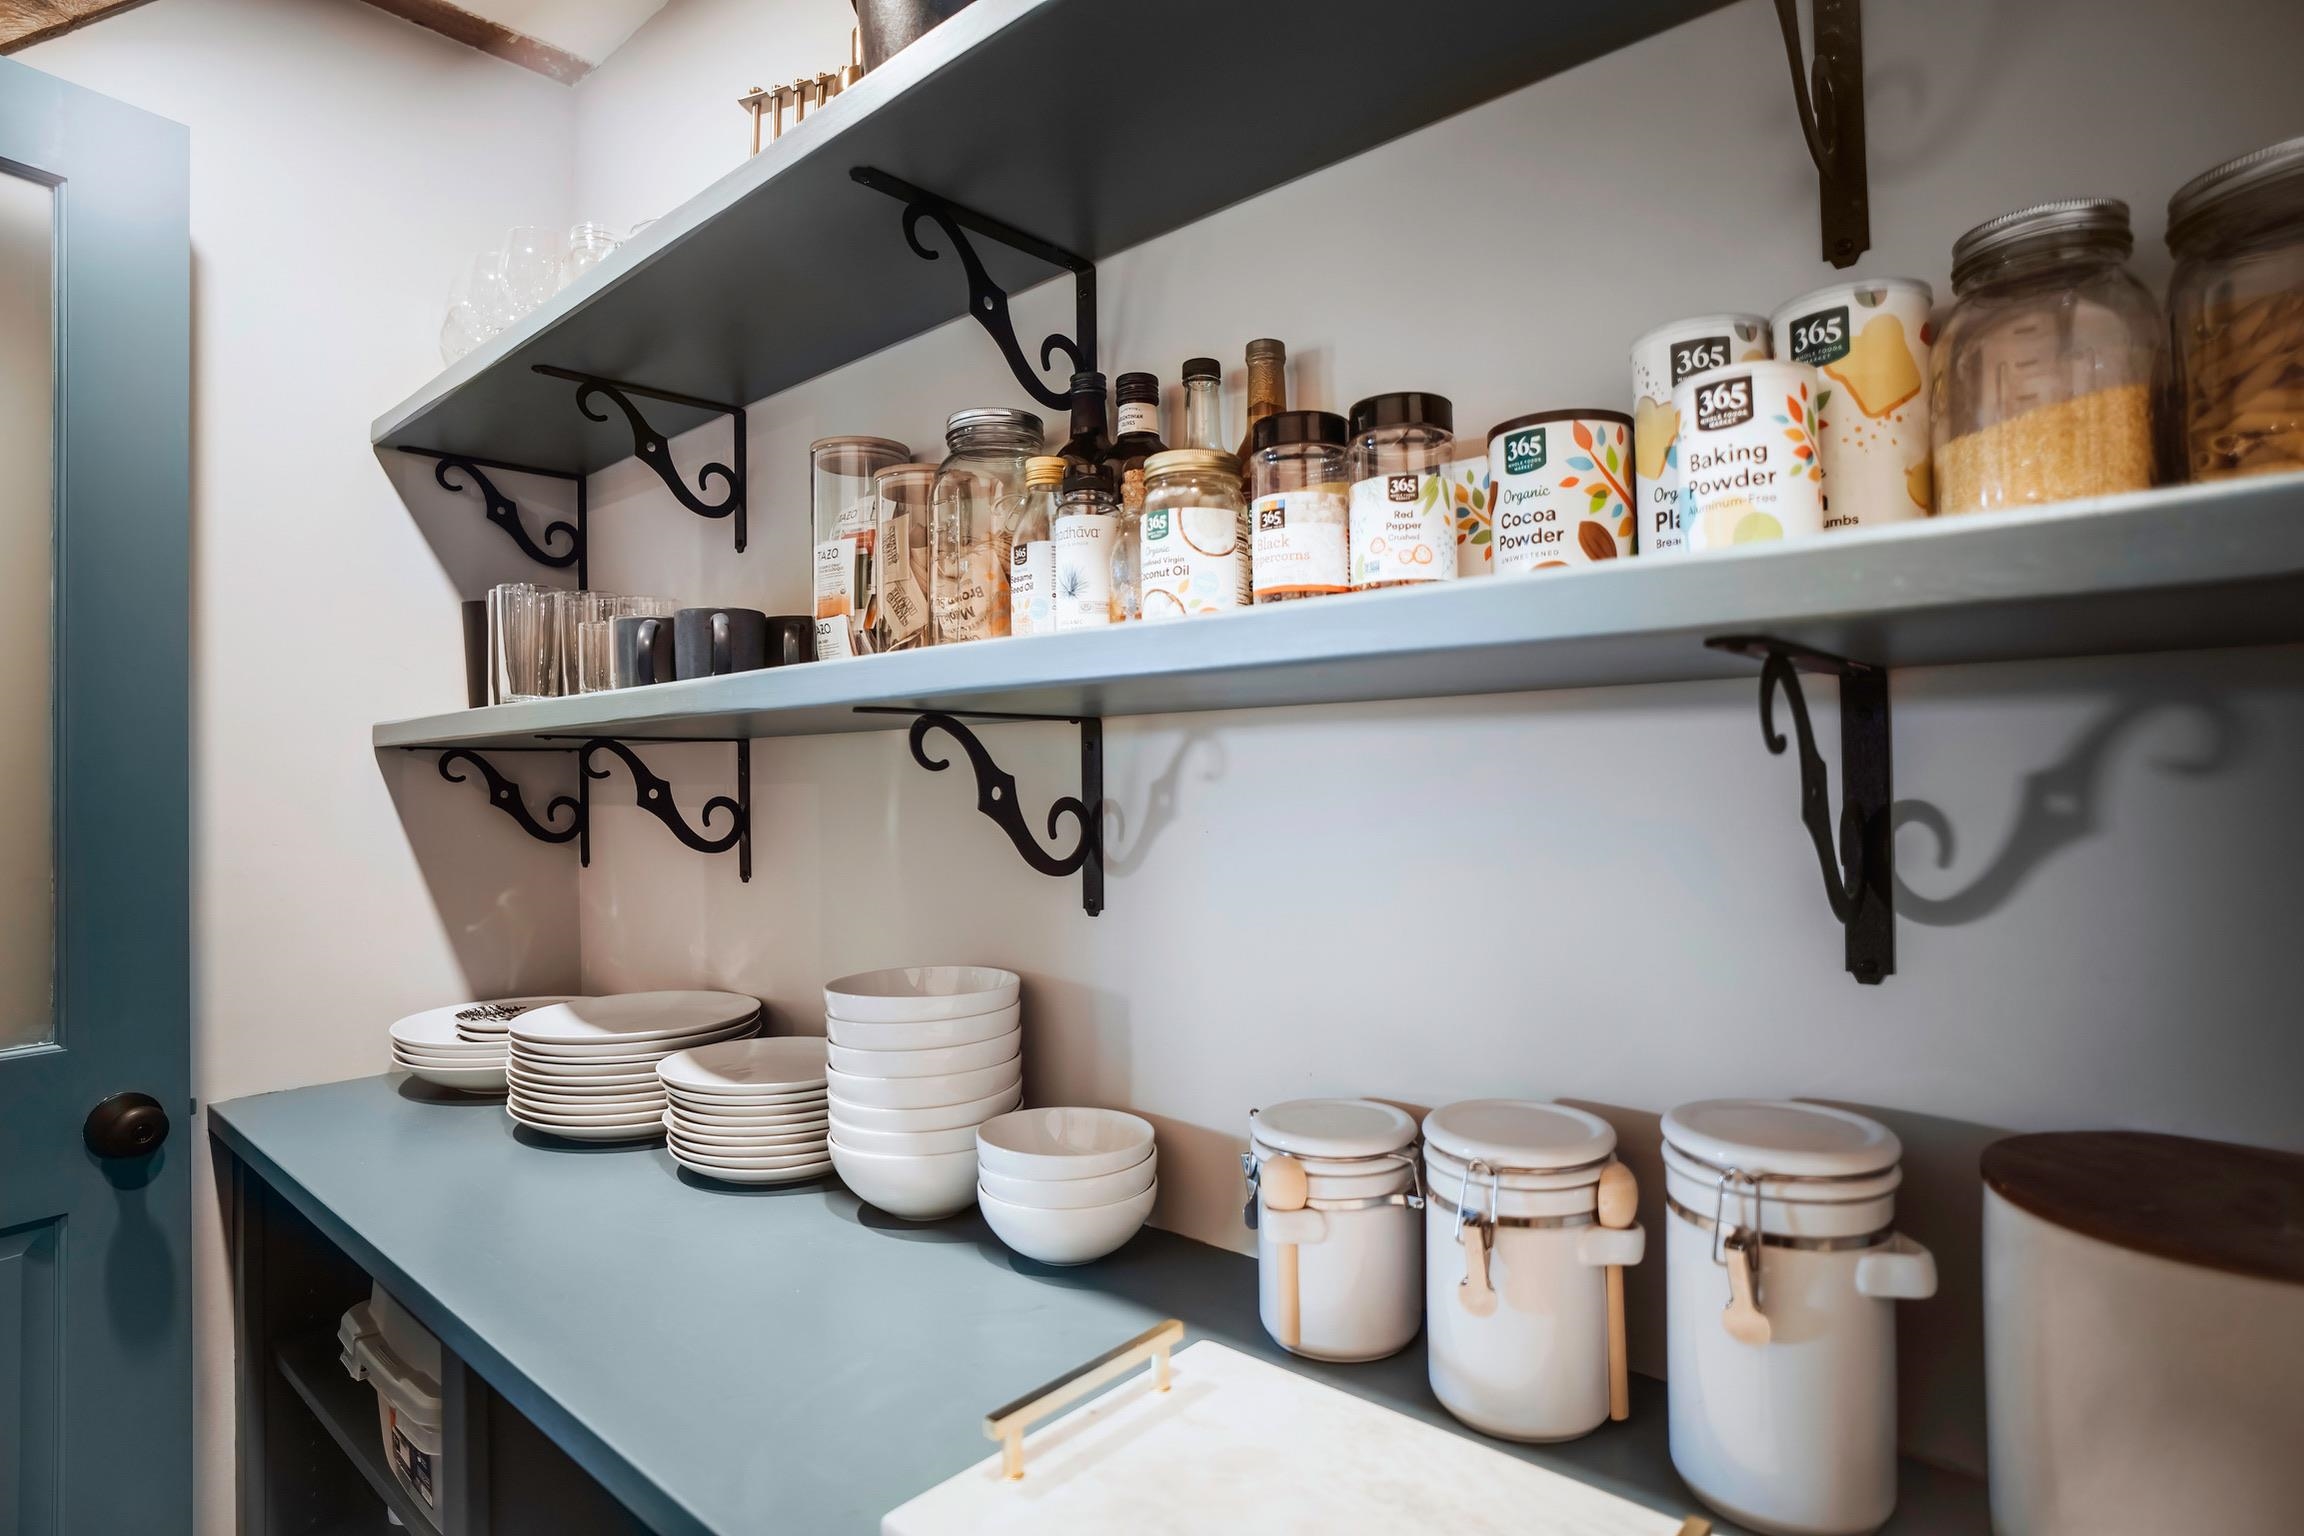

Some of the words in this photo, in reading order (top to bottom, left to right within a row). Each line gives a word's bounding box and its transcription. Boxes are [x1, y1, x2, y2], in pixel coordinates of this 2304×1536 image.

[1795, 317, 1841, 353] 365
[1676, 345, 1725, 374] 365
[1699, 382, 1748, 416] 365
[1508, 435, 1541, 461] 365
[1690, 444, 1768, 473] Baking
[1390, 478, 1416, 493] 365
[1689, 468, 1777, 500] Powder
[1504, 485, 1550, 505] Organic
[1688, 493, 1778, 517] Aluminum-Free
[1148, 514, 1167, 531] 365
[1262, 511, 1281, 527] 365
[1394, 510, 1413, 519] Red
[1501, 509, 1556, 530] Cocoa
[1385, 522, 1422, 531] Pepper
[1258, 533, 1289, 552] Black
[1499, 528, 1564, 552] Powder
[818, 548, 838, 559] TAZO
[1015, 546, 1026, 559] 365
[1172, 565, 1190, 576] Oil
